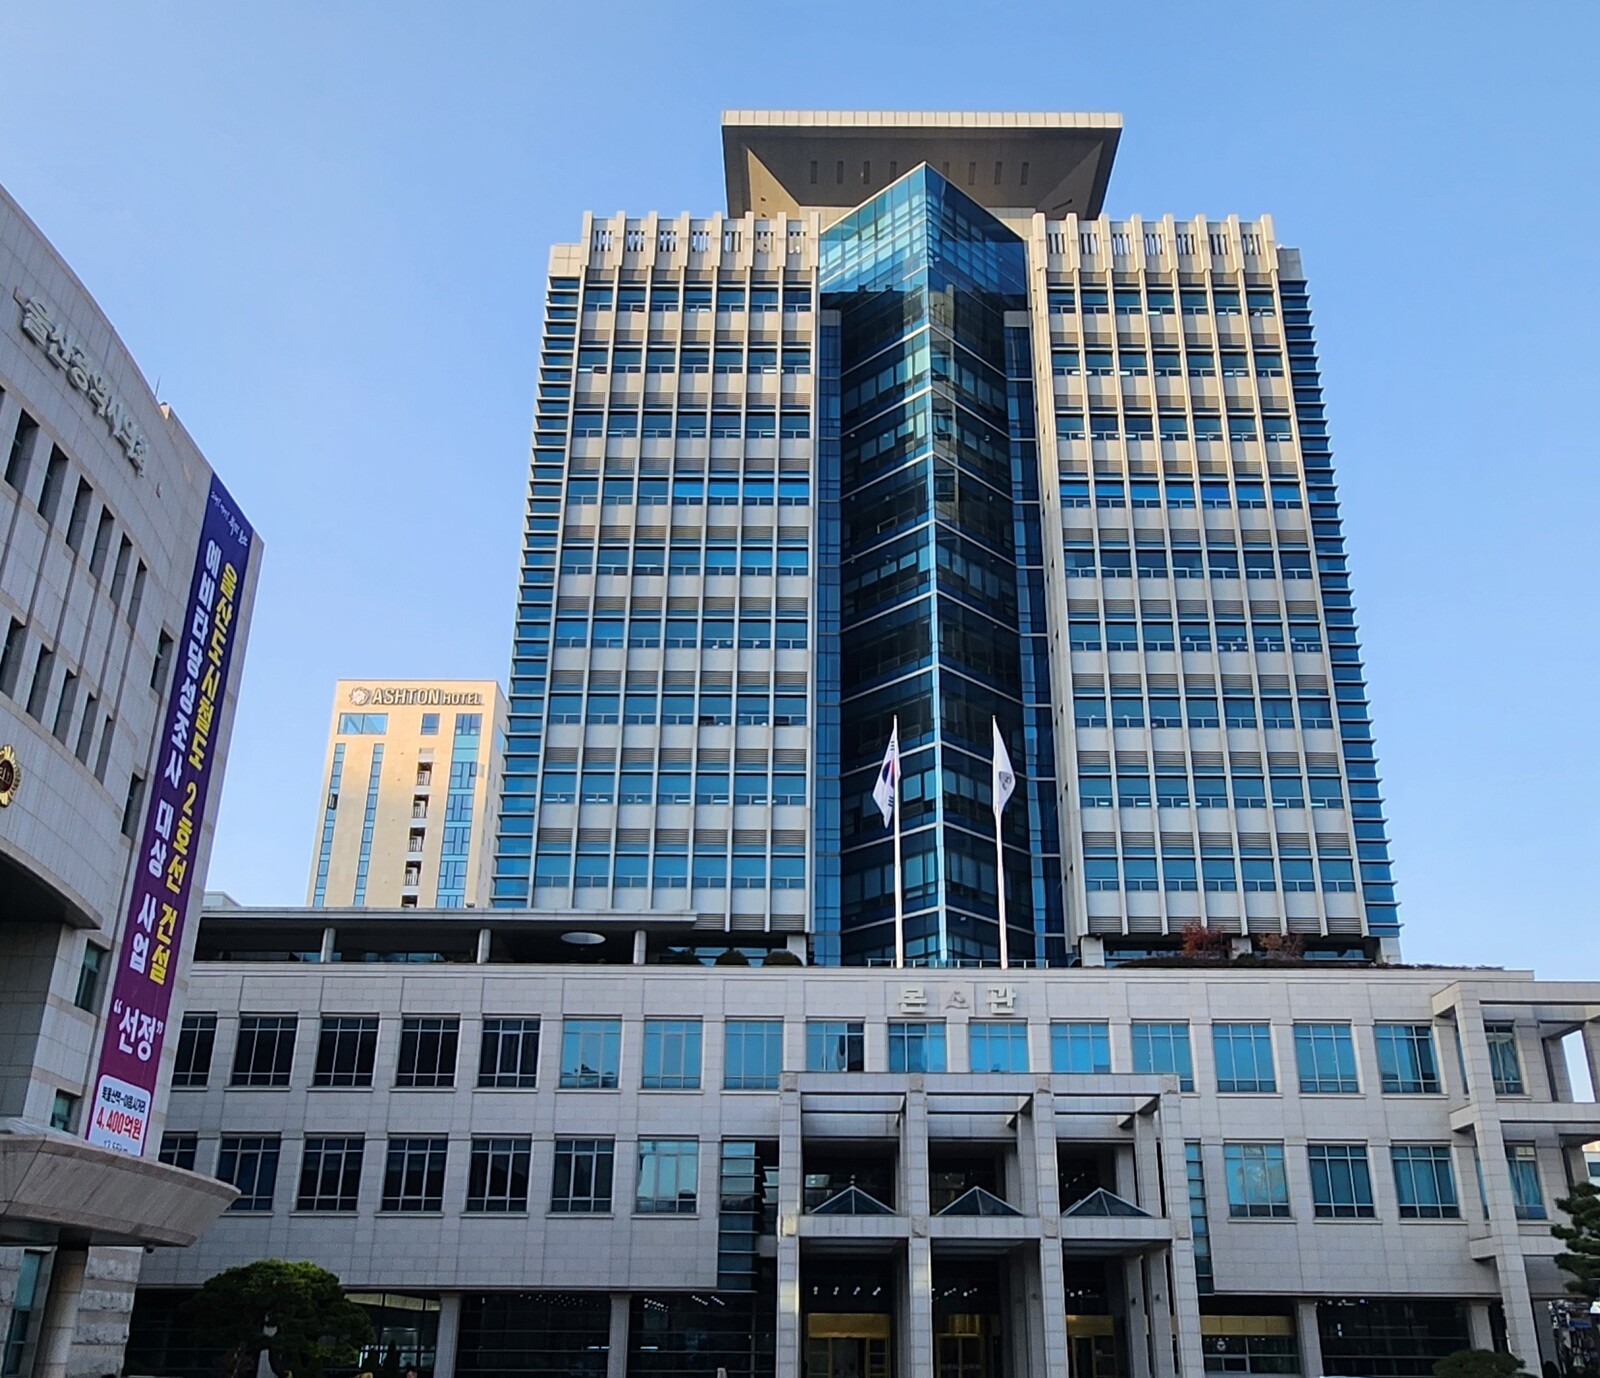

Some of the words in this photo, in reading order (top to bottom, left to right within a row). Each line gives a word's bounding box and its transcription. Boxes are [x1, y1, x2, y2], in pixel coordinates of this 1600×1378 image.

[164, 539, 222, 789] 예비타당성조사
[188, 562, 238, 771] 울산도시철도
[371, 687, 440, 705] ASHTON
[441, 692, 483, 706] HOTEL
[148, 798, 174, 879] 대상
[165, 781, 198, 895] 2호선
[129, 892, 157, 974] 사업
[149, 902, 178, 986] 건설
[96, 1106, 143, 1140] 4,400억원
